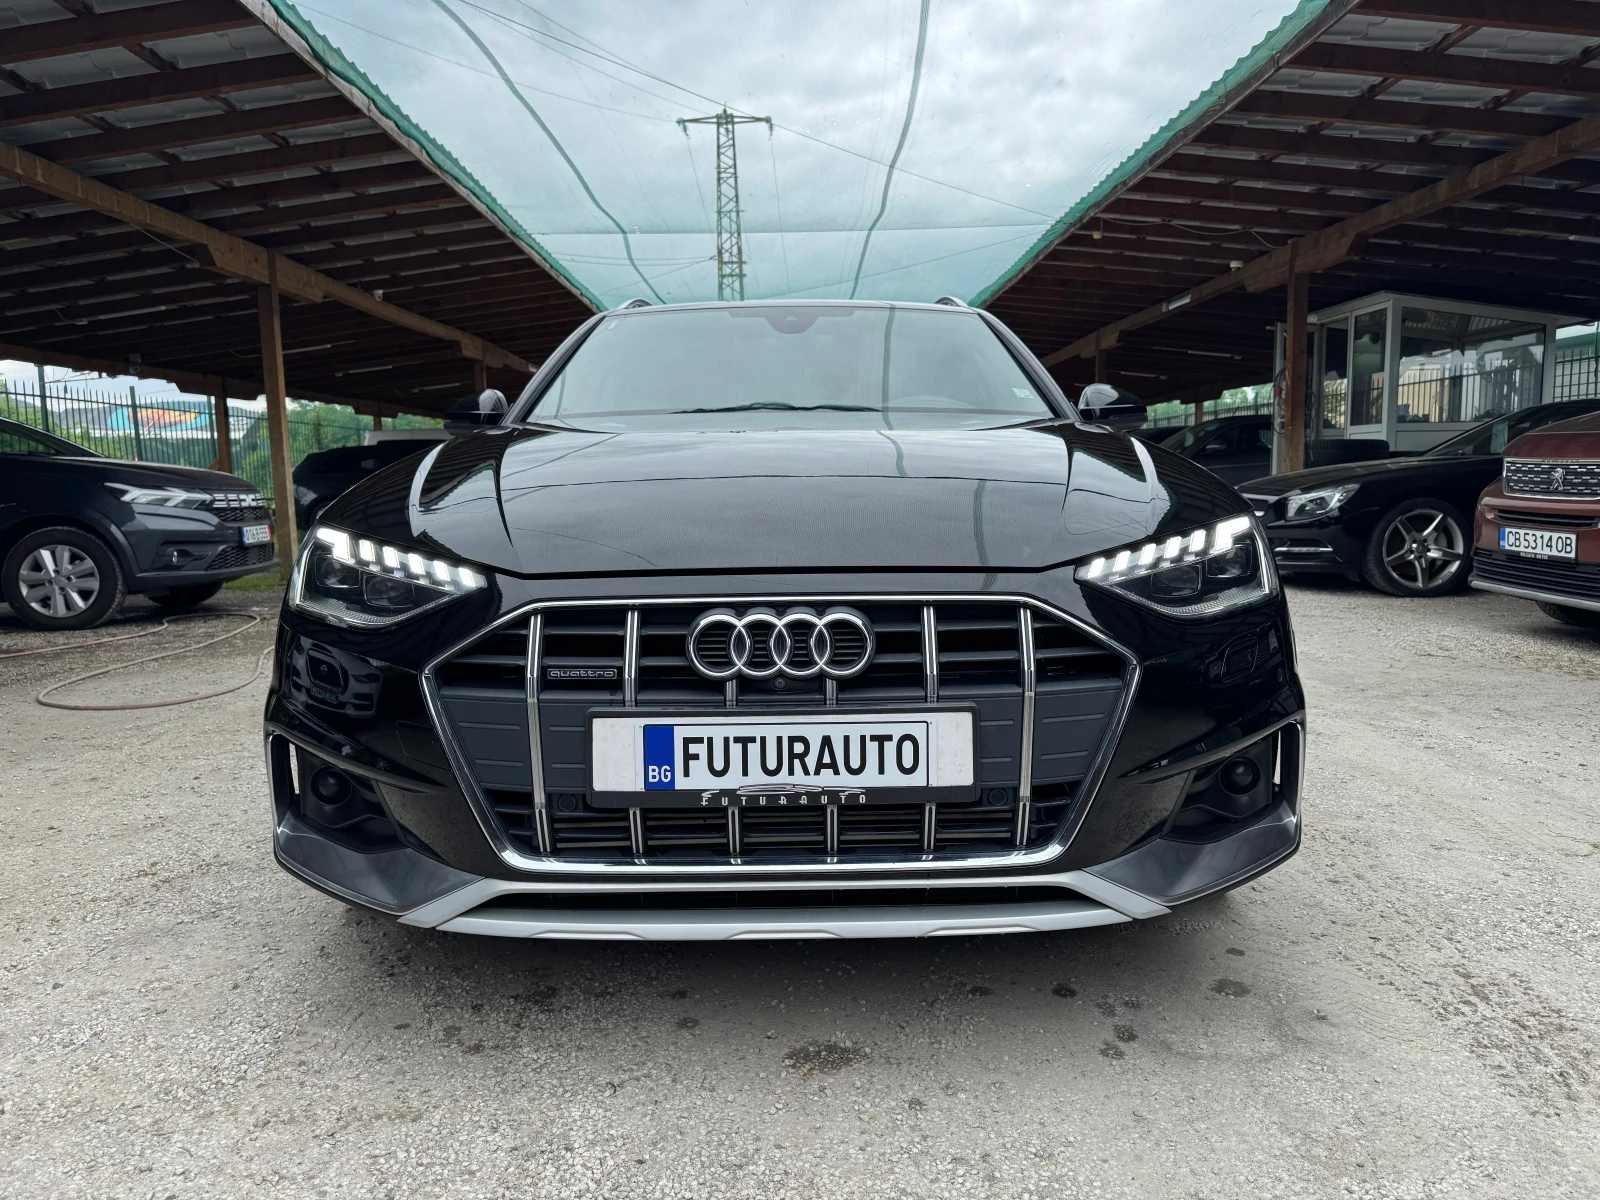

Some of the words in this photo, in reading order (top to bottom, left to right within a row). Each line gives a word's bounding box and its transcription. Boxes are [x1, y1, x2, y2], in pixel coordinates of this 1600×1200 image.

[550, 670, 614, 678] quattro
[648, 765, 672, 783] BG
[682, 733, 920, 778] FUTURAUTO
[701, 793, 866, 806] FUTURAUTO
